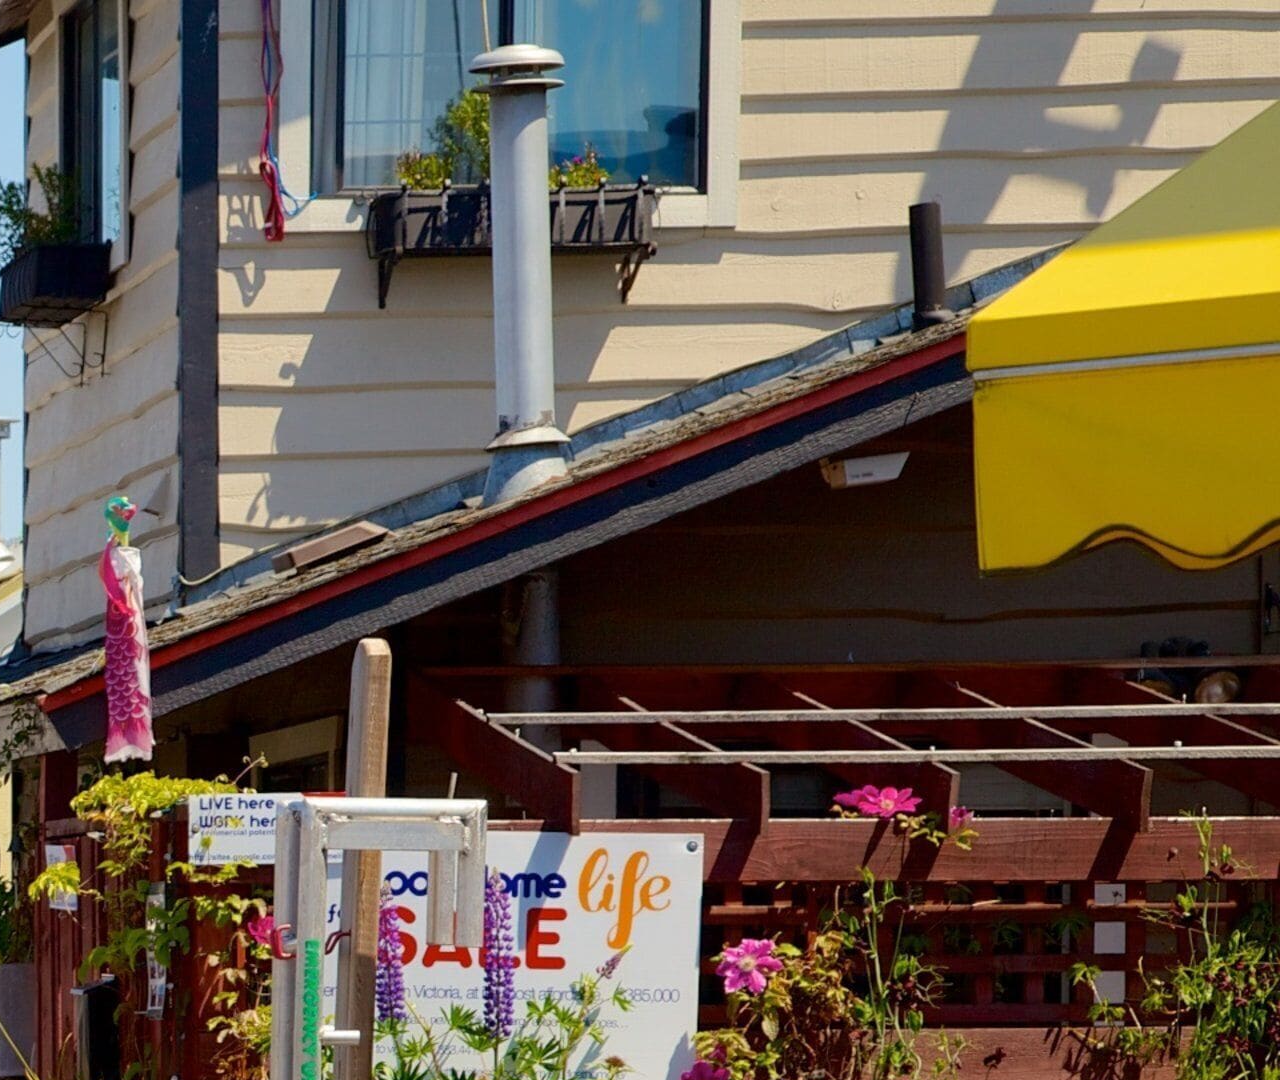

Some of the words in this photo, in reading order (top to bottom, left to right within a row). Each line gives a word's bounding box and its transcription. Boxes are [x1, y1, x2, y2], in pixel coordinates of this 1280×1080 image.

[200, 797, 233, 810] LIVE
[238, 797, 275, 809] here
[250, 816, 277, 828] her
[578, 847, 672, 950] life
[379, 907, 568, 971] SAE
[301, 940, 321, 1058] EMERGENCY
[413, 985, 462, 1000] Victoria,
[465, 987, 479, 998] at
[513, 987, 537, 999] ost
[624, 988, 681, 1003] 385,000
